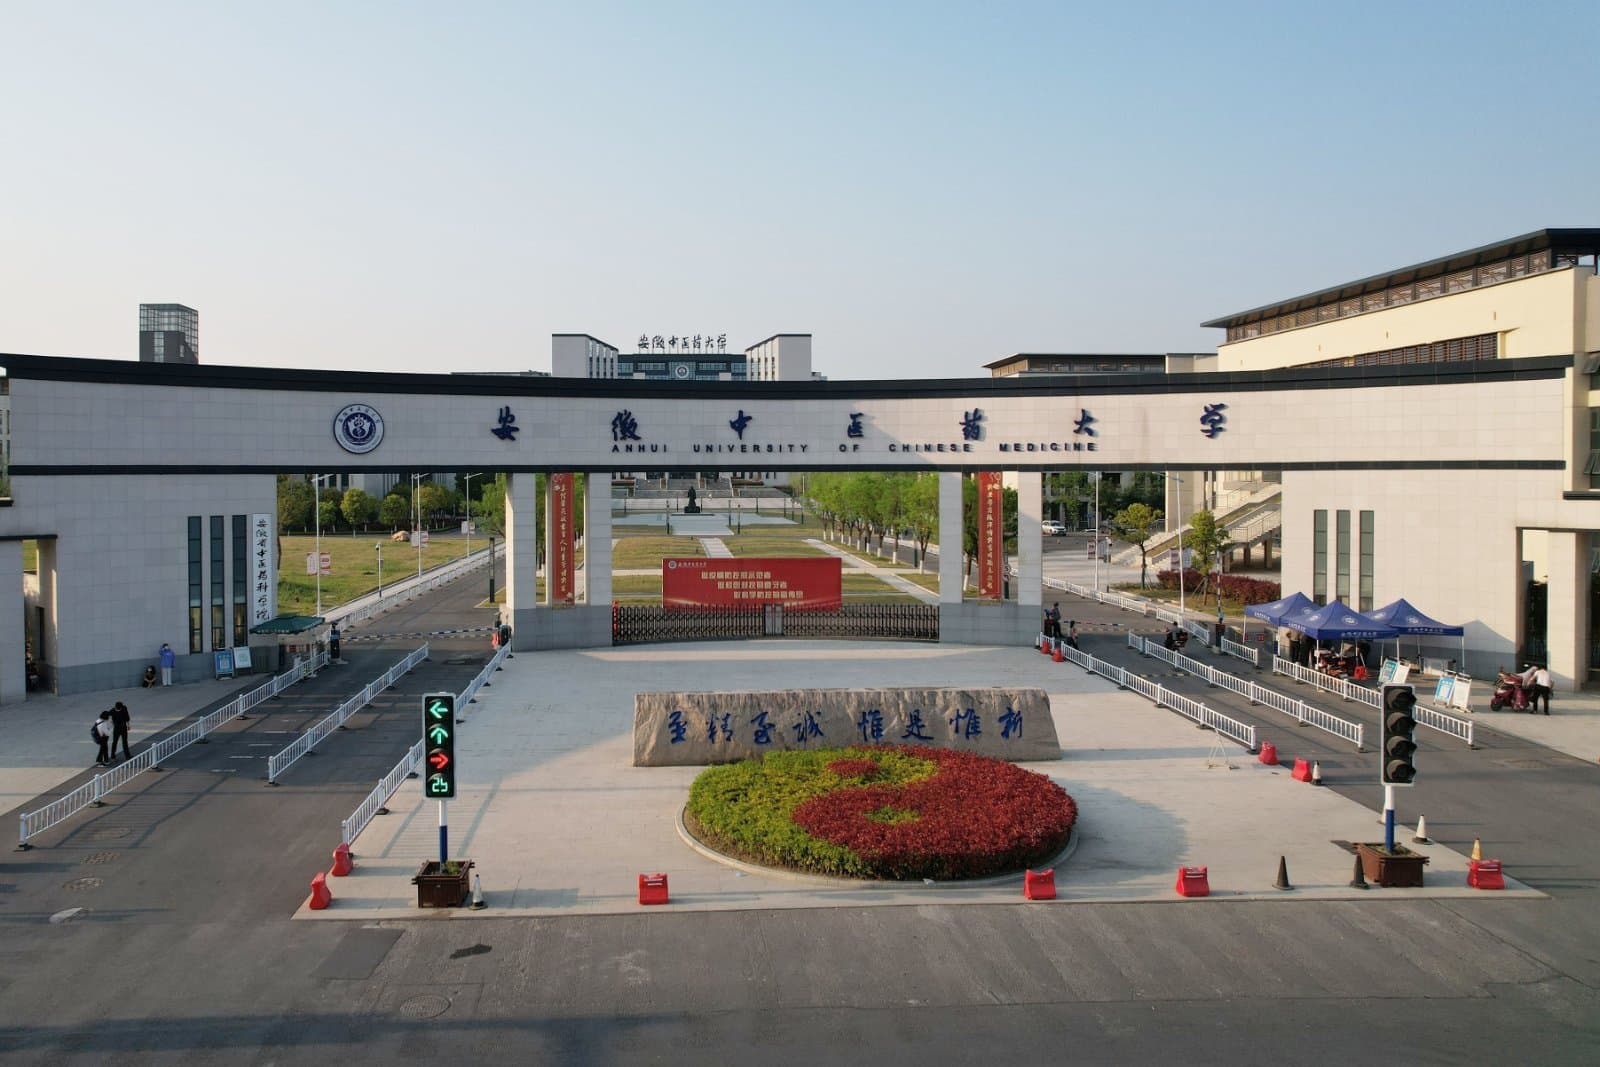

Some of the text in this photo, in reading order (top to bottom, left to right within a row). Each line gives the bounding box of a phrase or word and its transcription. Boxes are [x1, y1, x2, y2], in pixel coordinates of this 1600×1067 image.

[638, 332, 727, 349] 安徽中医药大学
[490, 402, 1227, 442] 安徽中医药大学
[611, 442, 1096, 453] ANHUI UNIVERSITY OF CHINESE MEDICINE
